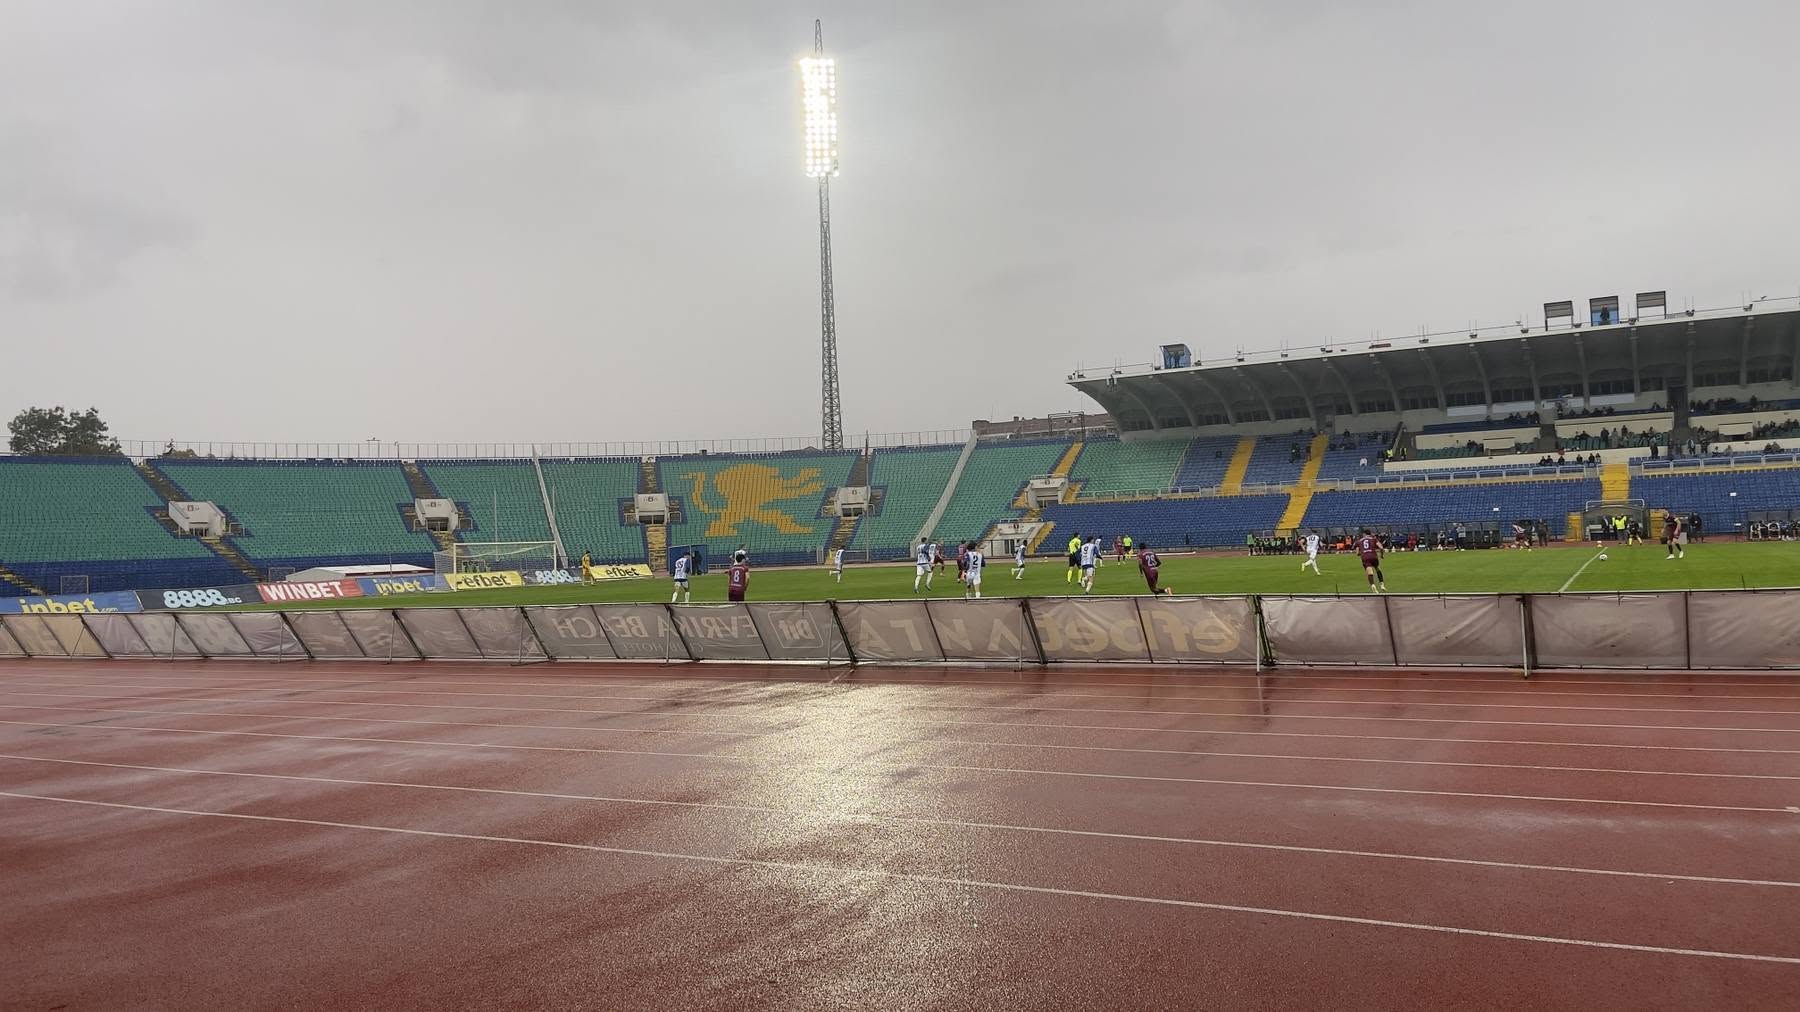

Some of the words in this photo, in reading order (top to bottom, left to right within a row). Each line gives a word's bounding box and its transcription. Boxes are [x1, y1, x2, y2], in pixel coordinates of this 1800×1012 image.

[1363, 539, 1370, 549] 6
[1083, 545, 1089, 555] 9
[972, 555, 979, 566] 2
[605, 567, 640, 577] efbet
[733, 570, 740, 582] 8
[463, 574, 511, 588] efbet
[264, 581, 344, 601] WINBET
